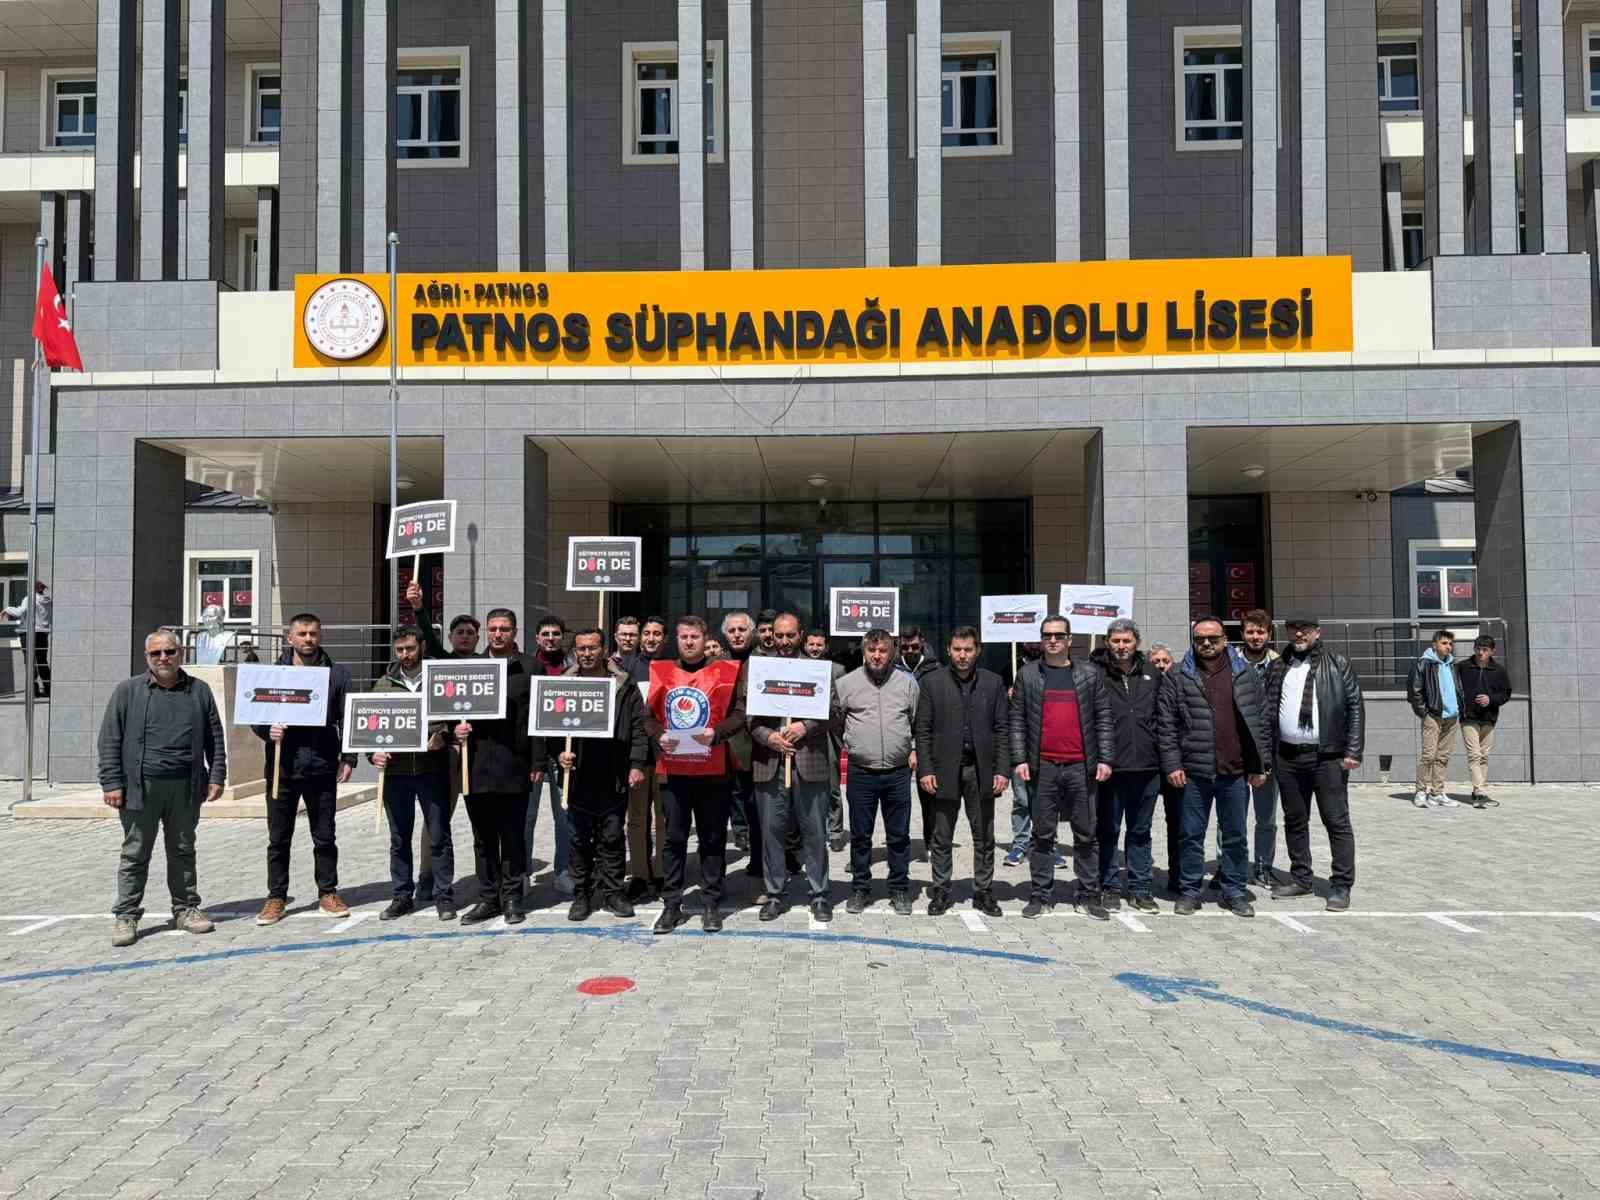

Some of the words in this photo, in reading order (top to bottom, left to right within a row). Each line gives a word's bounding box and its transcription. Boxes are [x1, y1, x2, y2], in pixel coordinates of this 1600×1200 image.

[411, 312, 591, 352] PATNOS
[605, 296, 900, 353] SÜPHANDAĞI
[916, 301, 1148, 348] ANADOLU
[1166, 288, 1313, 342] LİSESİ
[426, 519, 446, 532] DE
[611, 558, 631, 571] DE
[872, 606, 890, 617] DE
[472, 682, 495, 696] DE
[581, 698, 604, 712] DE
[394, 716, 417, 729] DE
